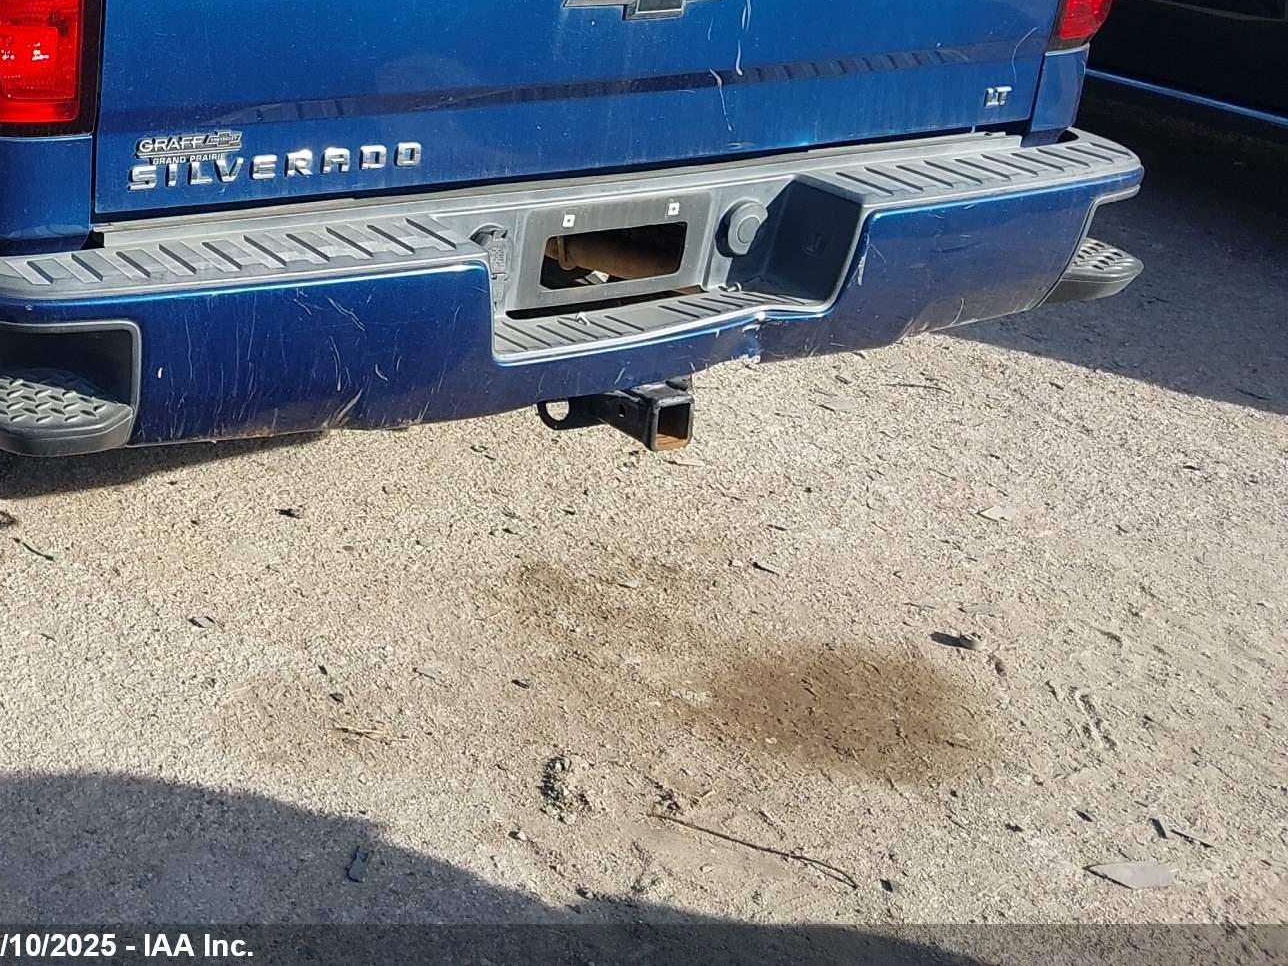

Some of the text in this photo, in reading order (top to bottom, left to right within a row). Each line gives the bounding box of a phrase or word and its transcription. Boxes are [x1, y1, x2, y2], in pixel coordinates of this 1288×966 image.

[984, 86, 1013, 107] LT
[139, 136, 206, 152] GRAFF
[128, 141, 422, 191] SILVERADO
[153, 153, 225, 165] GRAND PRAIRIE
